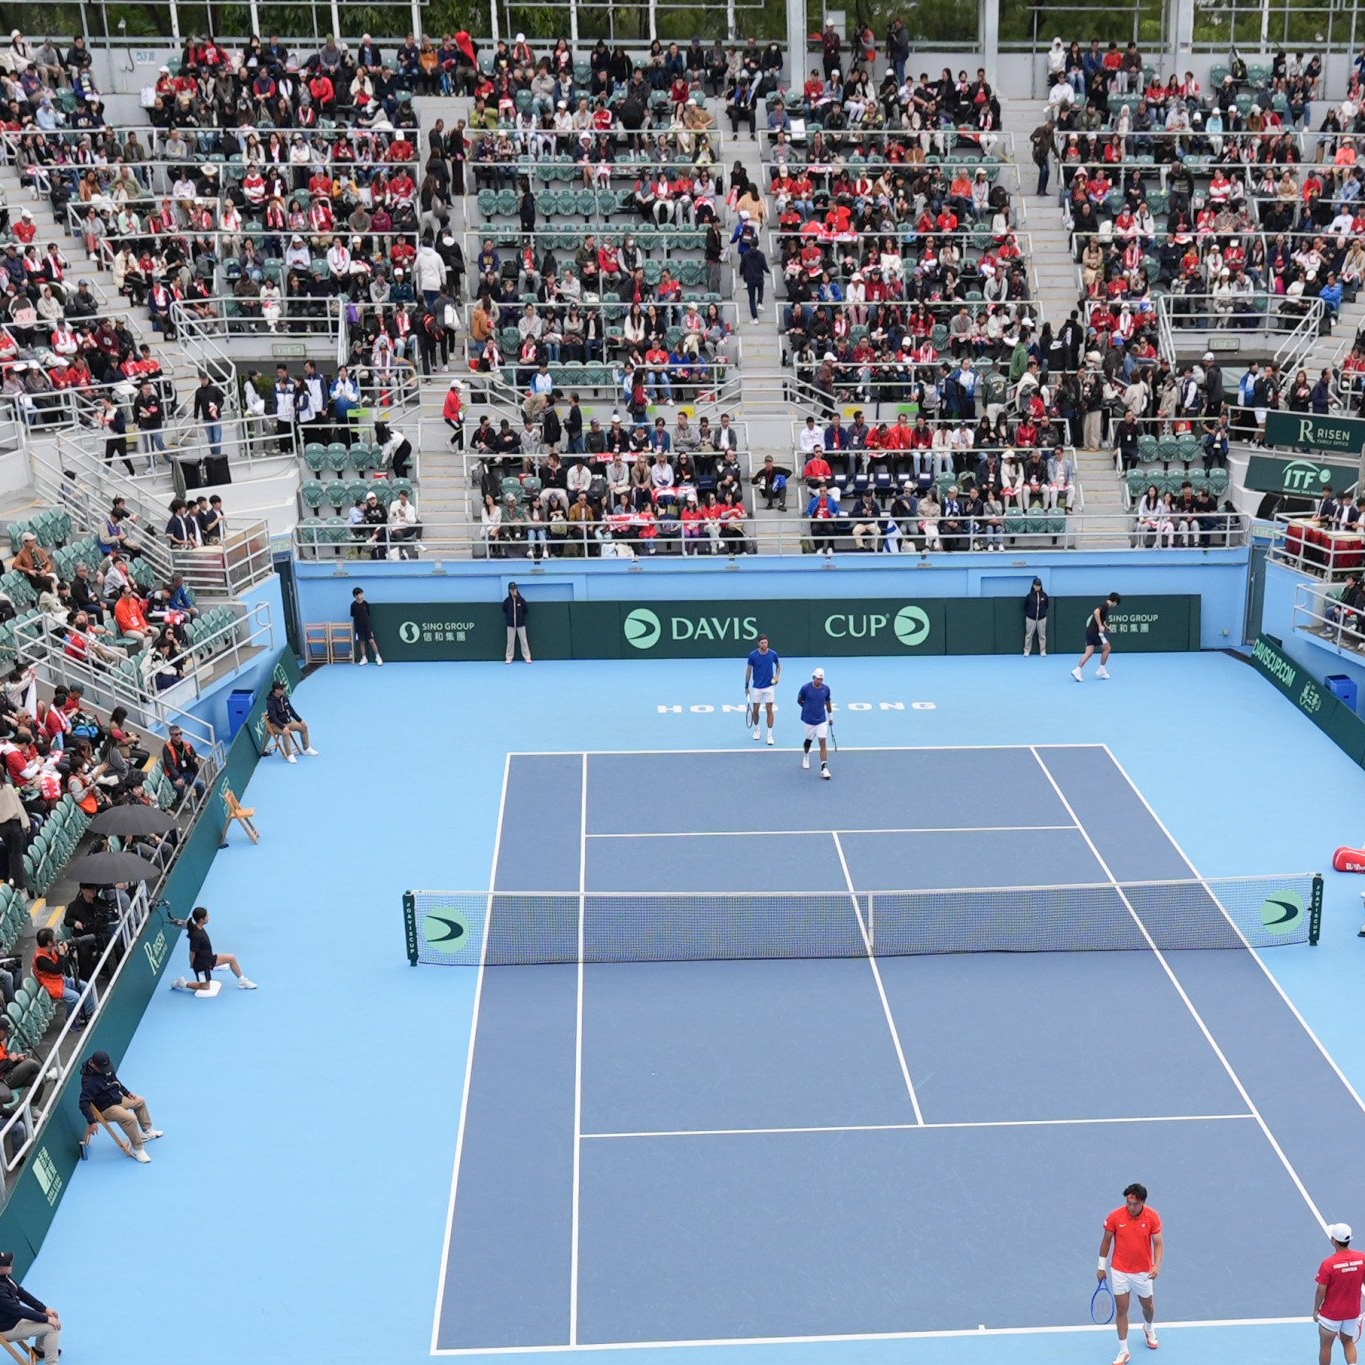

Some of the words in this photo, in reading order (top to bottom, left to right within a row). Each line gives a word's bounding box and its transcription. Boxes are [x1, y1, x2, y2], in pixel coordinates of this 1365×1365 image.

[1317, 428, 1350, 441] RISEN
[1284, 469, 1317, 489] ITF
[1129, 614, 1159, 622] GROUP
[422, 622, 444, 631] SINO
[445, 622, 475, 630] GROUP
[671, 617, 759, 640] DAVIS
[824, 614, 886, 638] CUP
[423, 632, 466, 642] 信和集團
[1253, 638, 1296, 687] DAVISCUP.COM
